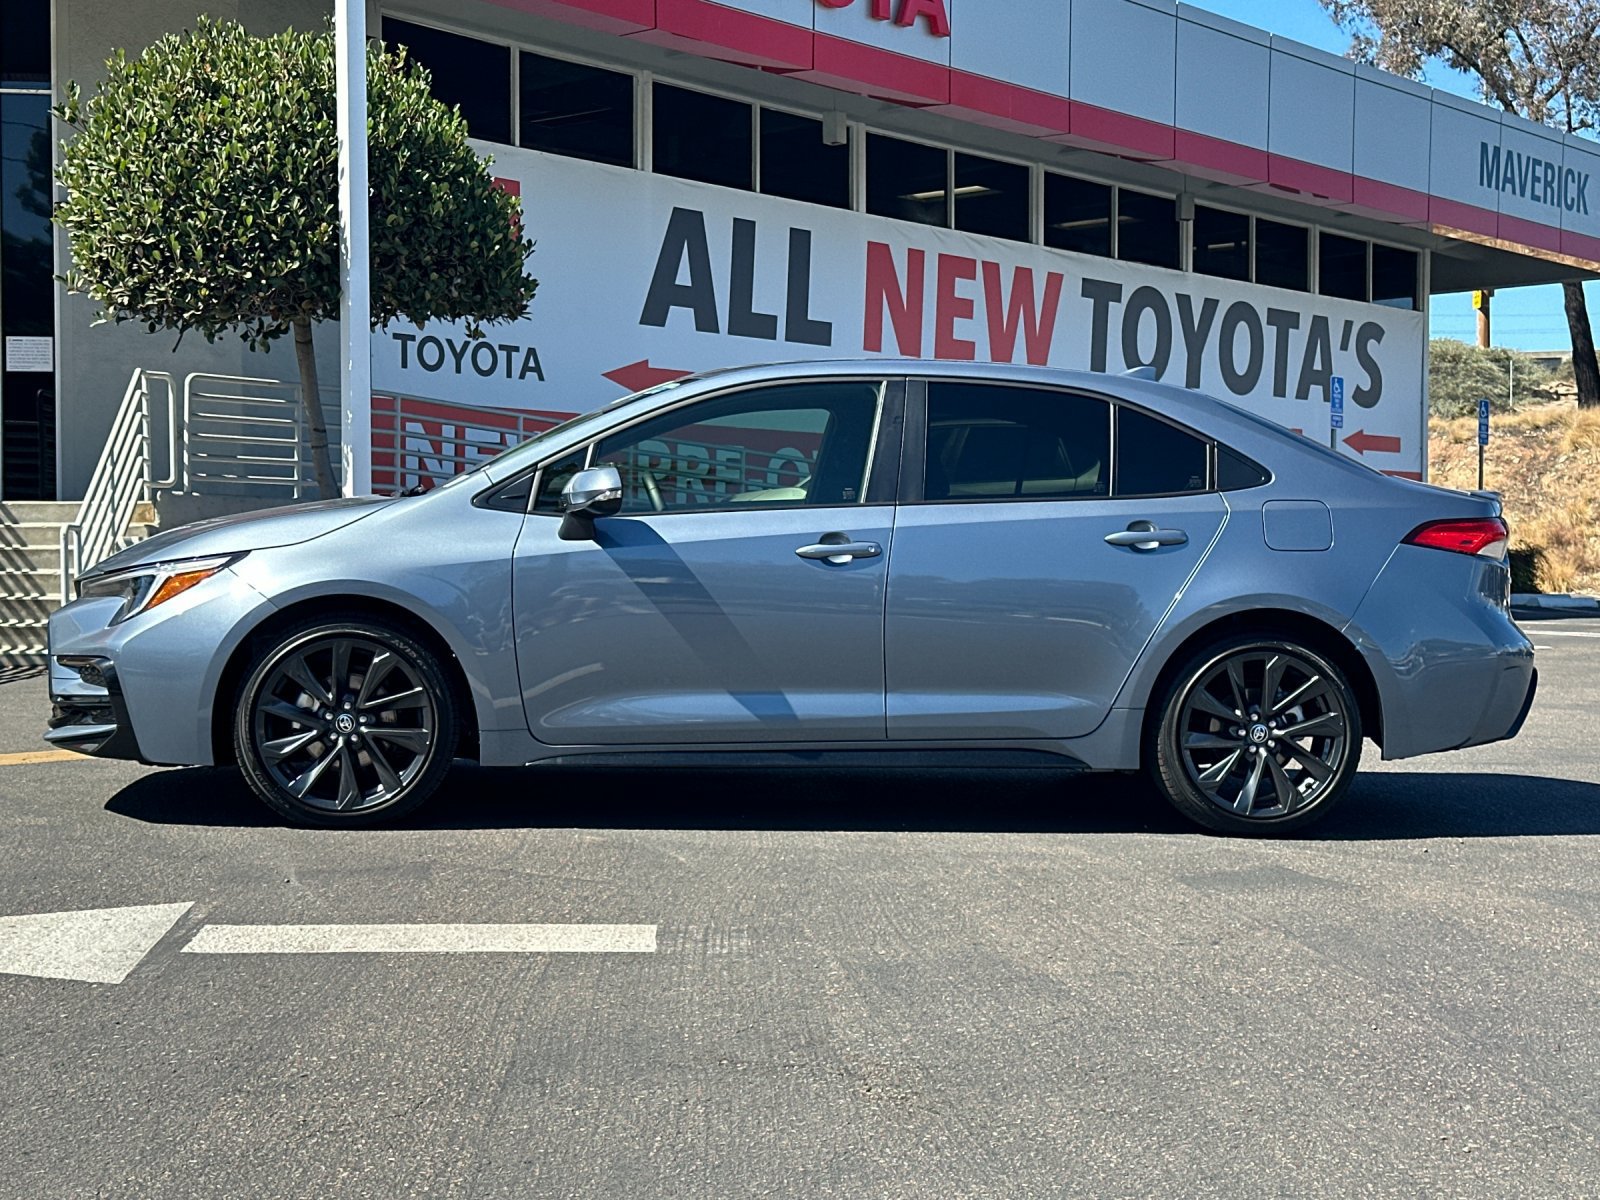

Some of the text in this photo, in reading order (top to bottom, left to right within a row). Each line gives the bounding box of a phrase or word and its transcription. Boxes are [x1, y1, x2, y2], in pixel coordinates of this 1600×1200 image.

[1479, 141, 1590, 216] MAVERICK
[639, 206, 1386, 409] ALL NEW TOYOTA'S
[392, 332, 546, 382] TOYOTA
[405, 421, 541, 489] NE
